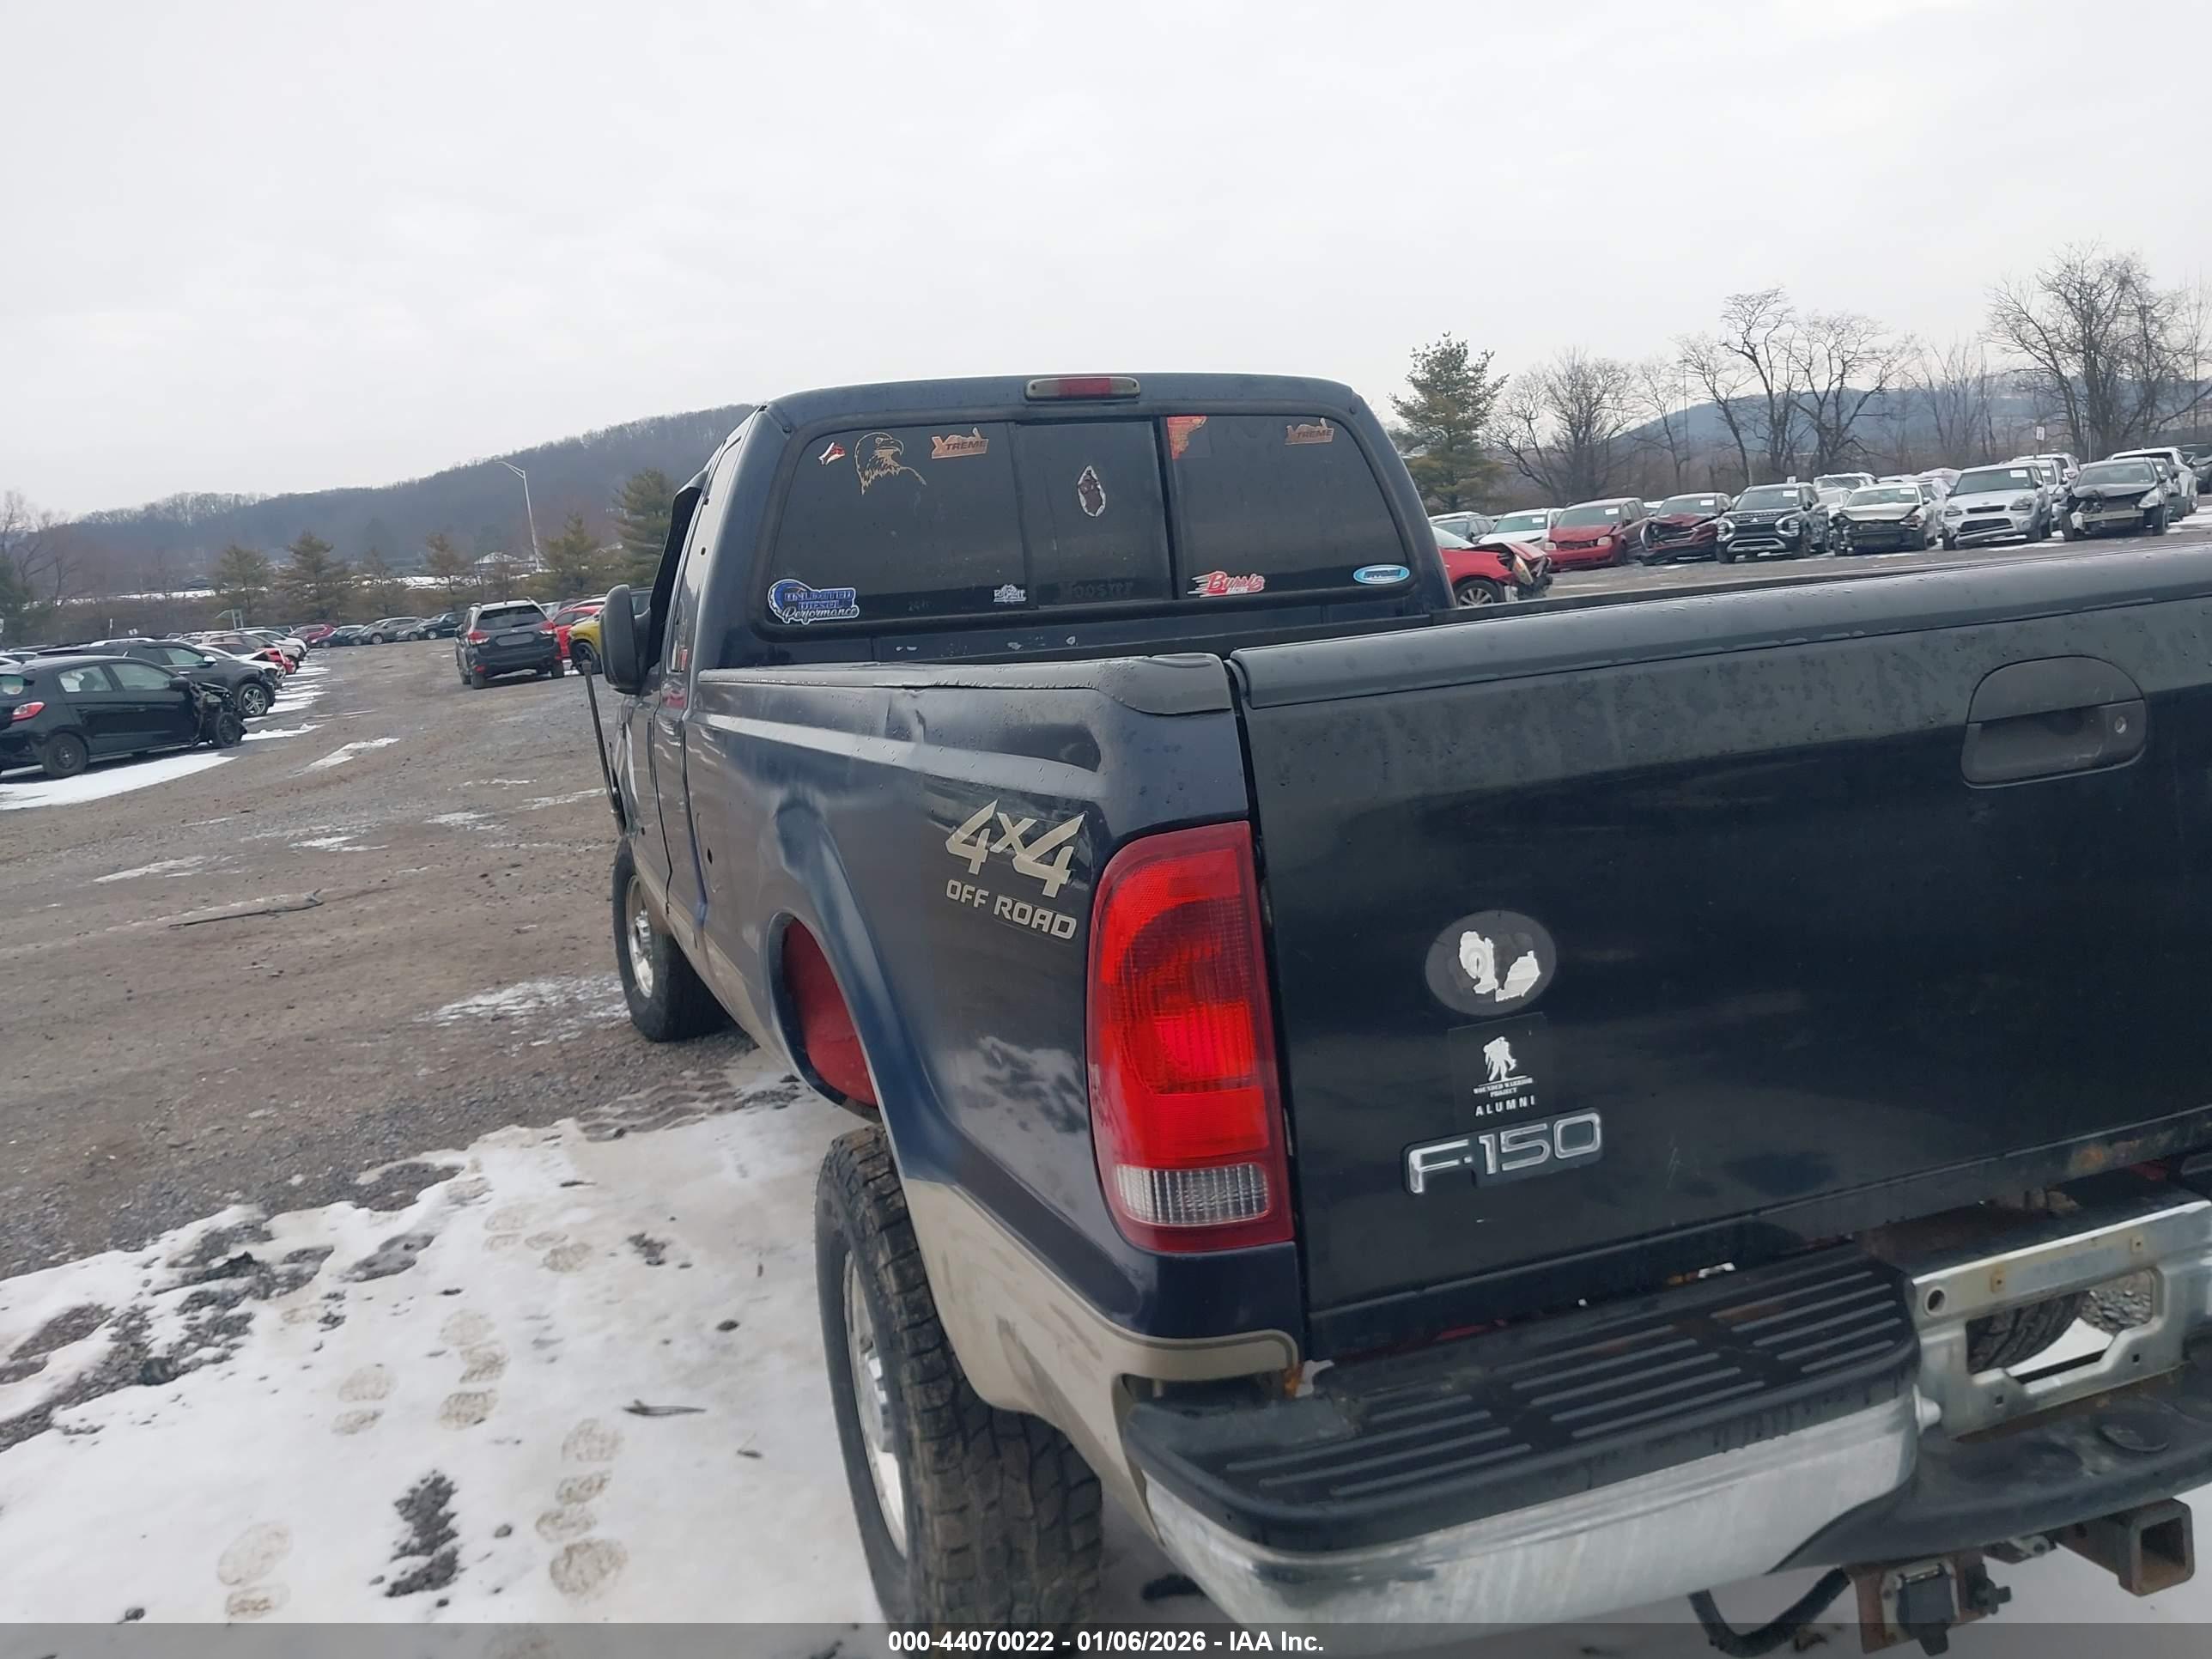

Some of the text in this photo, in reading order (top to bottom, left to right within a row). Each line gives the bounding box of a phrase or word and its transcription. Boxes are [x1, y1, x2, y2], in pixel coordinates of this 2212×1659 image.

[932, 436, 988, 457] XTREME
[784, 590, 853, 601] UNLIMITED
[798, 600, 843, 610] DIESEL
[782, 606, 856, 622] Performance
[946, 878, 989, 908] OFF
[993, 895, 1077, 939] ROAD
[1475, 1095, 1535, 1117] ALUMNI
[1407, 1111, 1601, 1194] F-150
